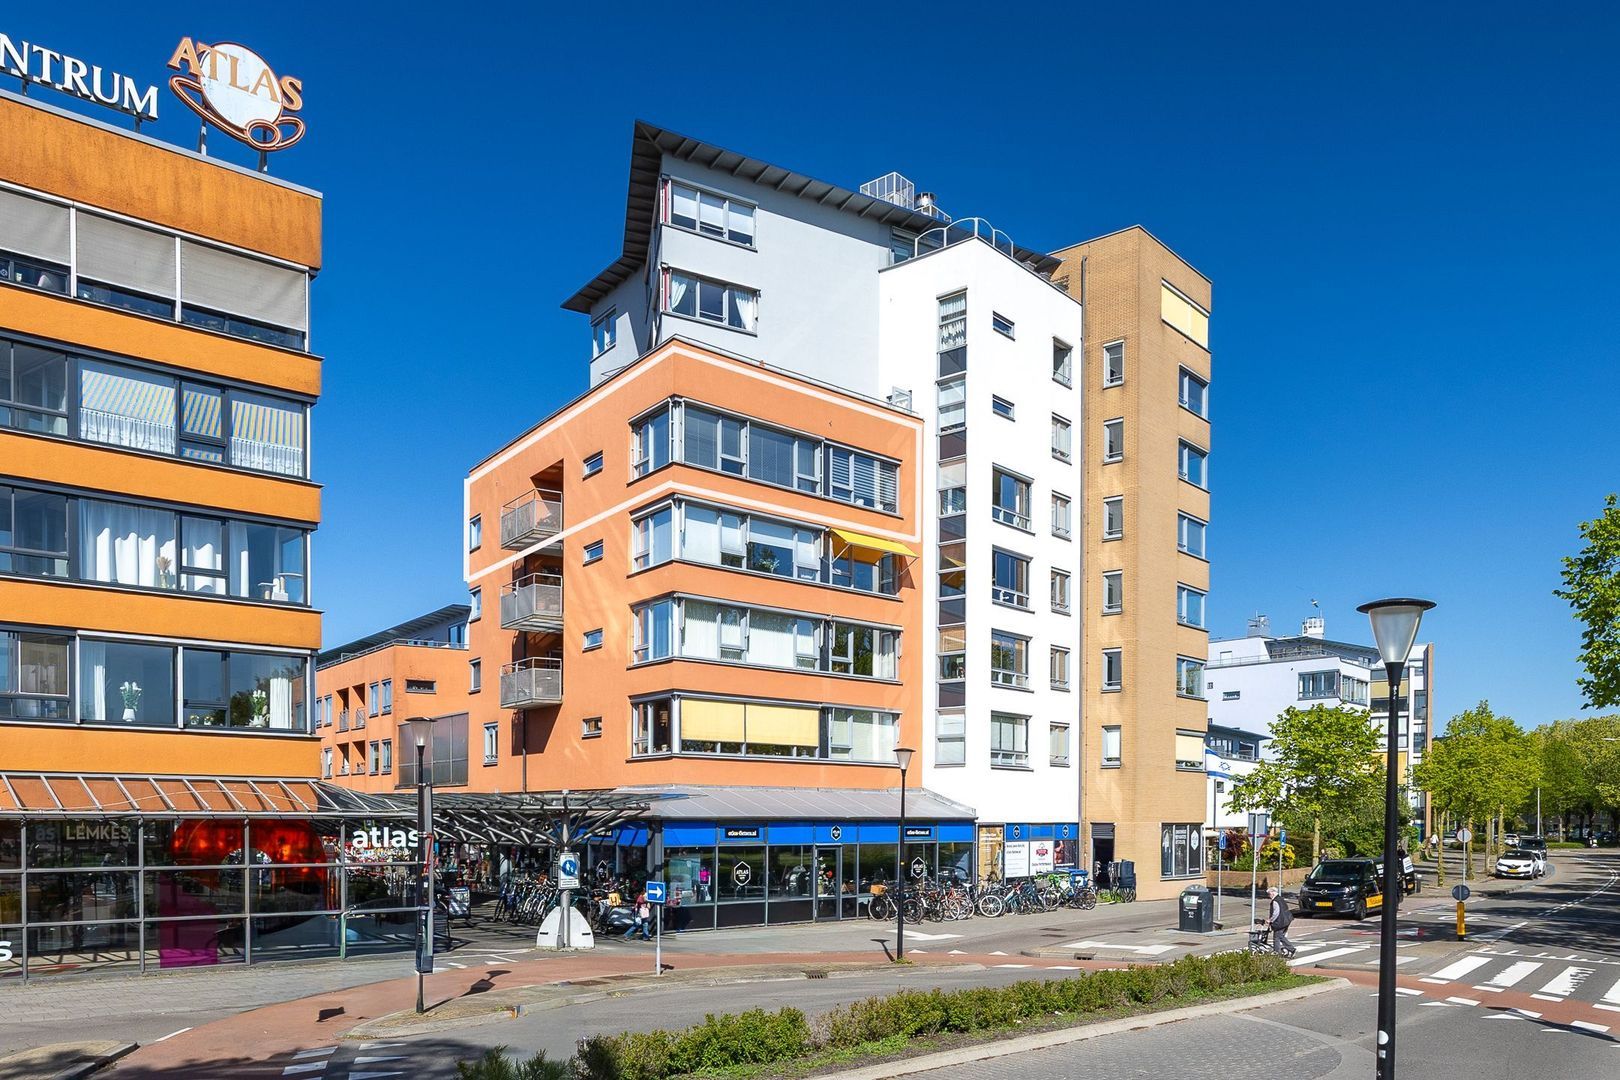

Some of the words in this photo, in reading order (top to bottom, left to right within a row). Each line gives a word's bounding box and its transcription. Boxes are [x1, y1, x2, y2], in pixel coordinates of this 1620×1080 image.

[167, 36, 302, 111] ATLAS
[66, 825, 129, 840] LEMKES
[352, 826, 418, 848] atlas
